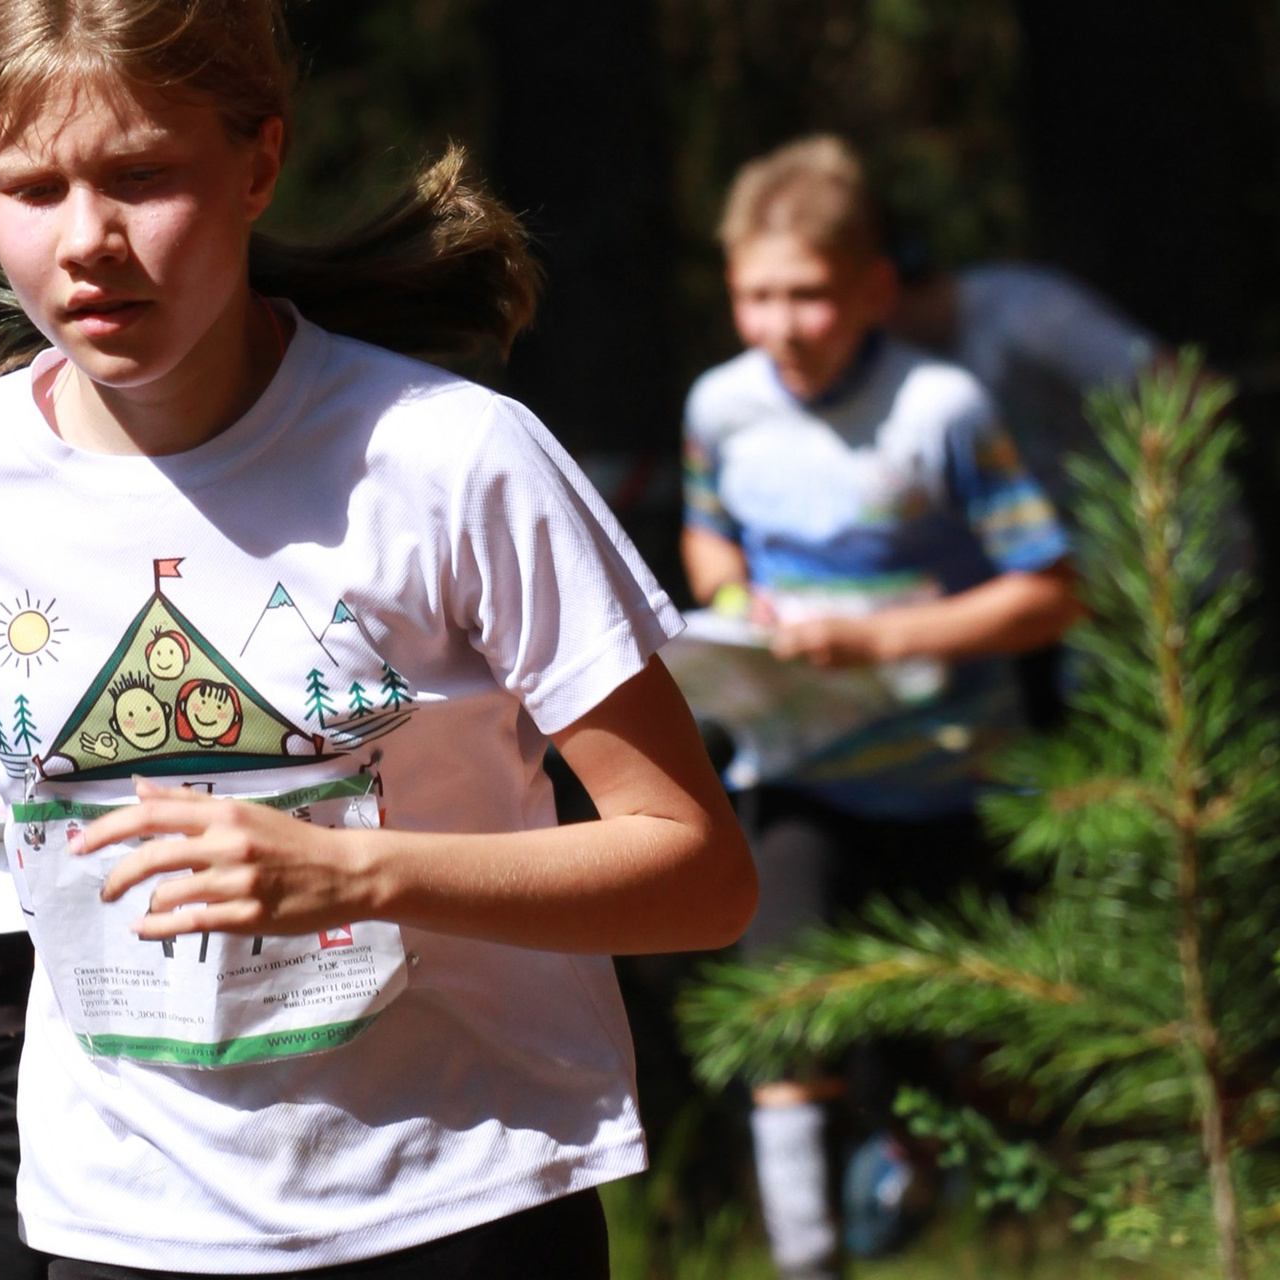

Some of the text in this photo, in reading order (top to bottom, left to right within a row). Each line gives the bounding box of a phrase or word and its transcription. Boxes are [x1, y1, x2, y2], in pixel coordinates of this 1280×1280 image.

[318, 961, 339, 971] Ж14
[263, 978, 377, 1004] 11:17:00 11:16:00 11:07:00
